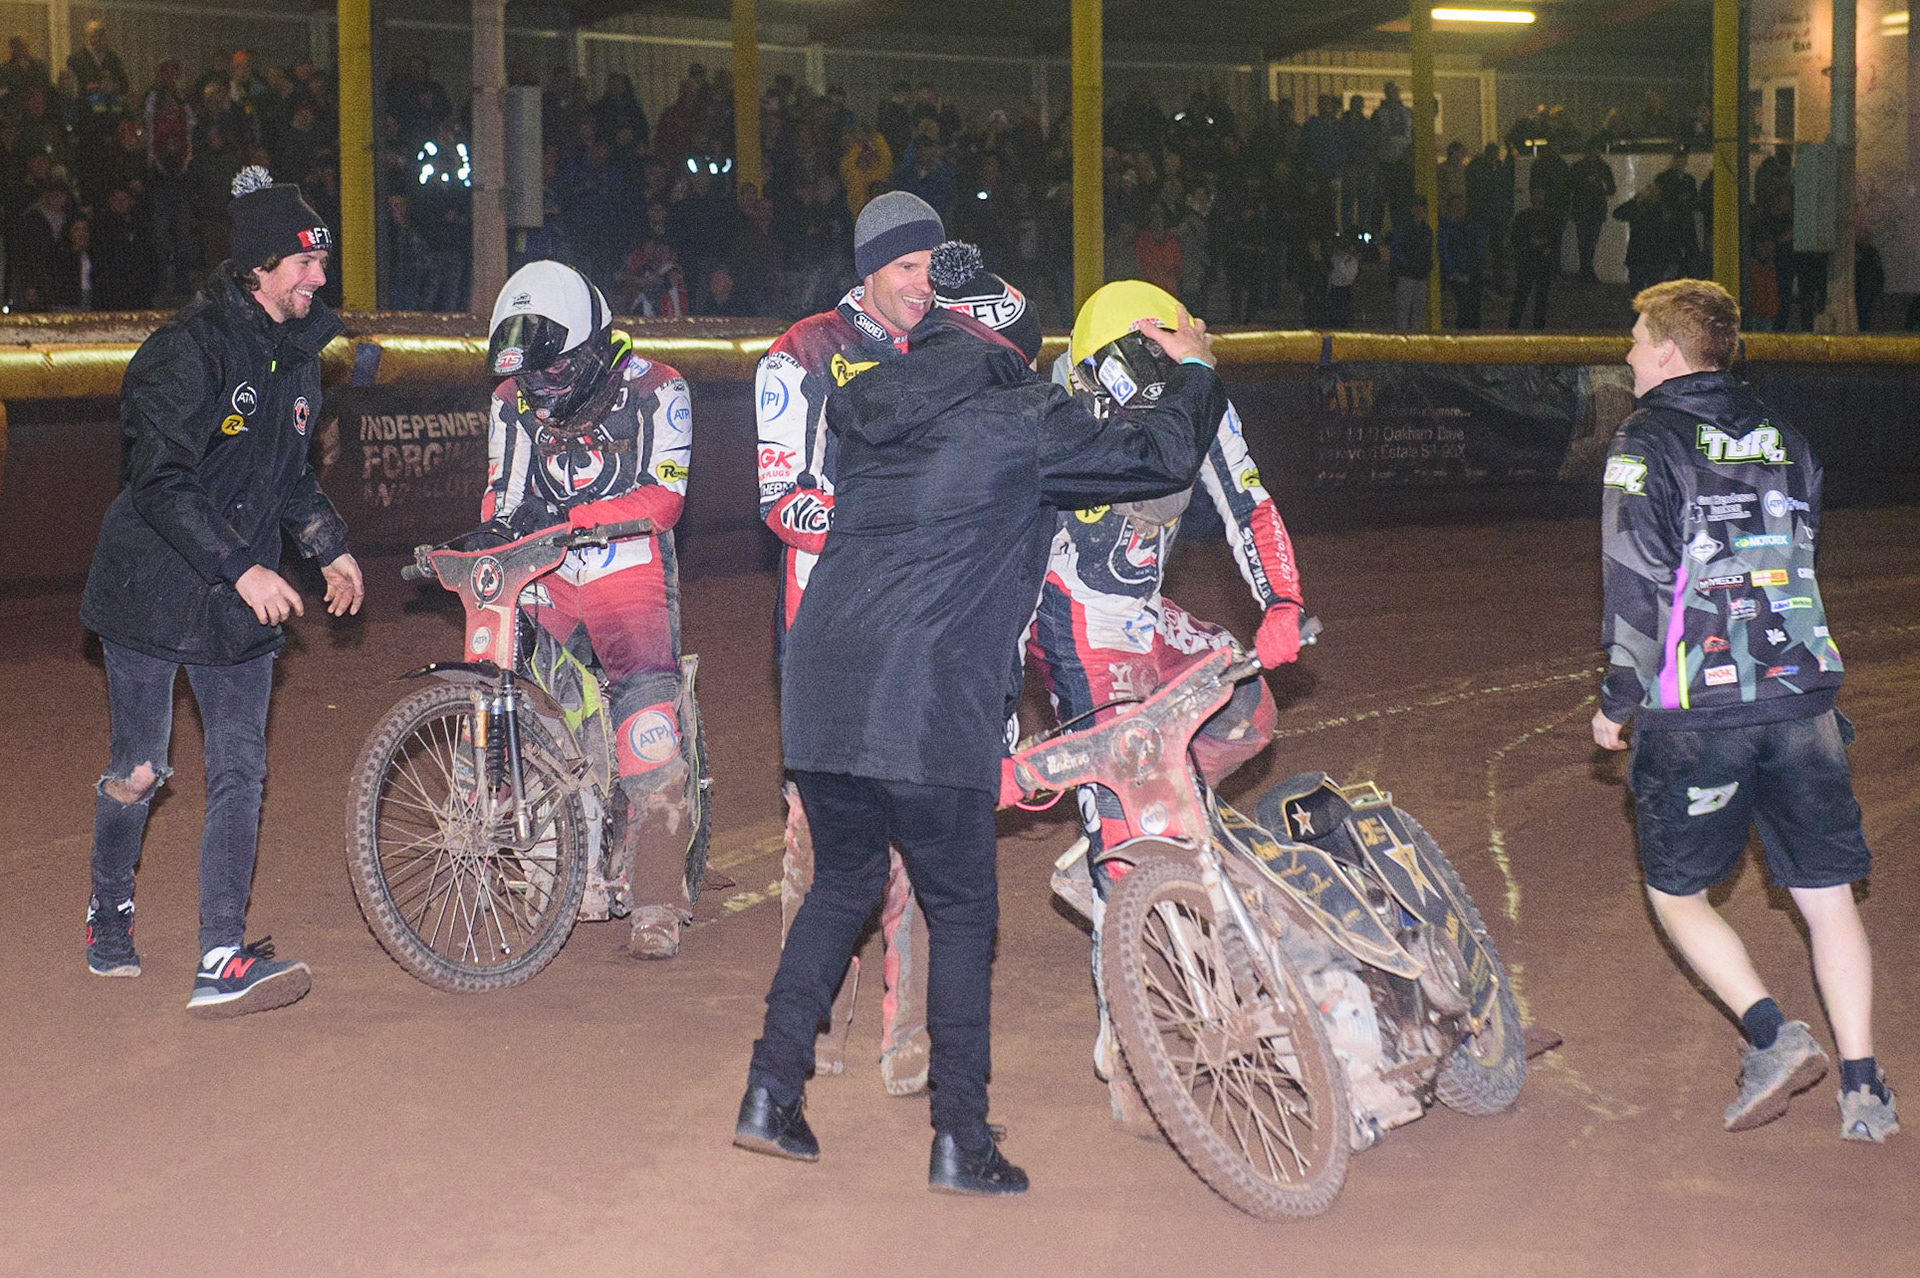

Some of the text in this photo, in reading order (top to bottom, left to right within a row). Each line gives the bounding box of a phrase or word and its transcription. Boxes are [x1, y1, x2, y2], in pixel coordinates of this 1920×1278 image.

[856, 314, 883, 339] SHOEI
[1703, 428, 1778, 459] TBR
[757, 448, 797, 469] GK
[638, 724, 670, 748] ATPI
